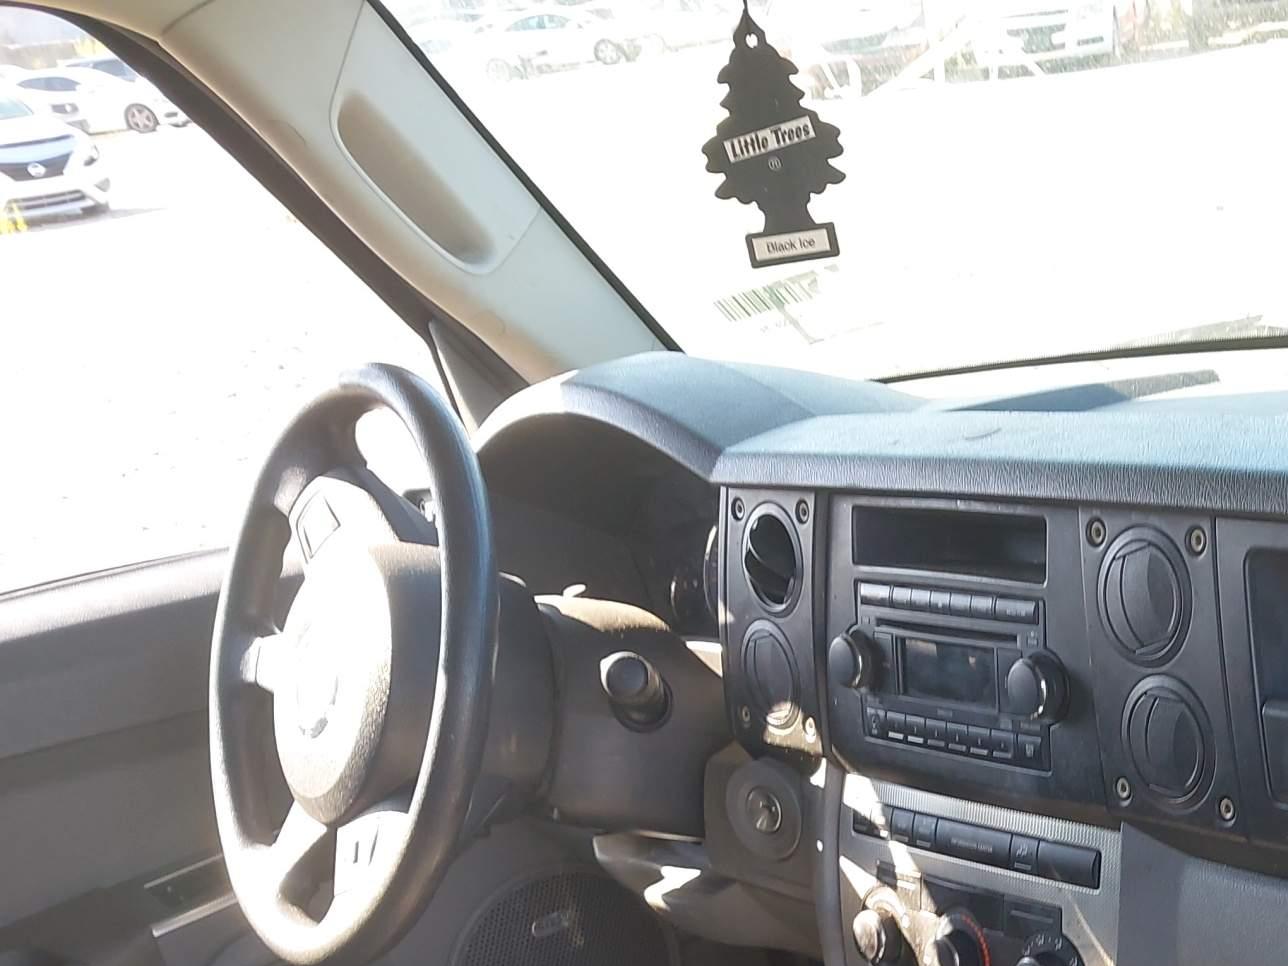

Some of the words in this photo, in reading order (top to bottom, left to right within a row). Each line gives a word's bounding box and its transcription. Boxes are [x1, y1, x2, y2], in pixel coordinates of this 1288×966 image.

[731, 133, 769, 160] Little
[770, 122, 811, 147] Trees
[766, 239, 797, 254] Black
[799, 236, 816, 249] Ice
